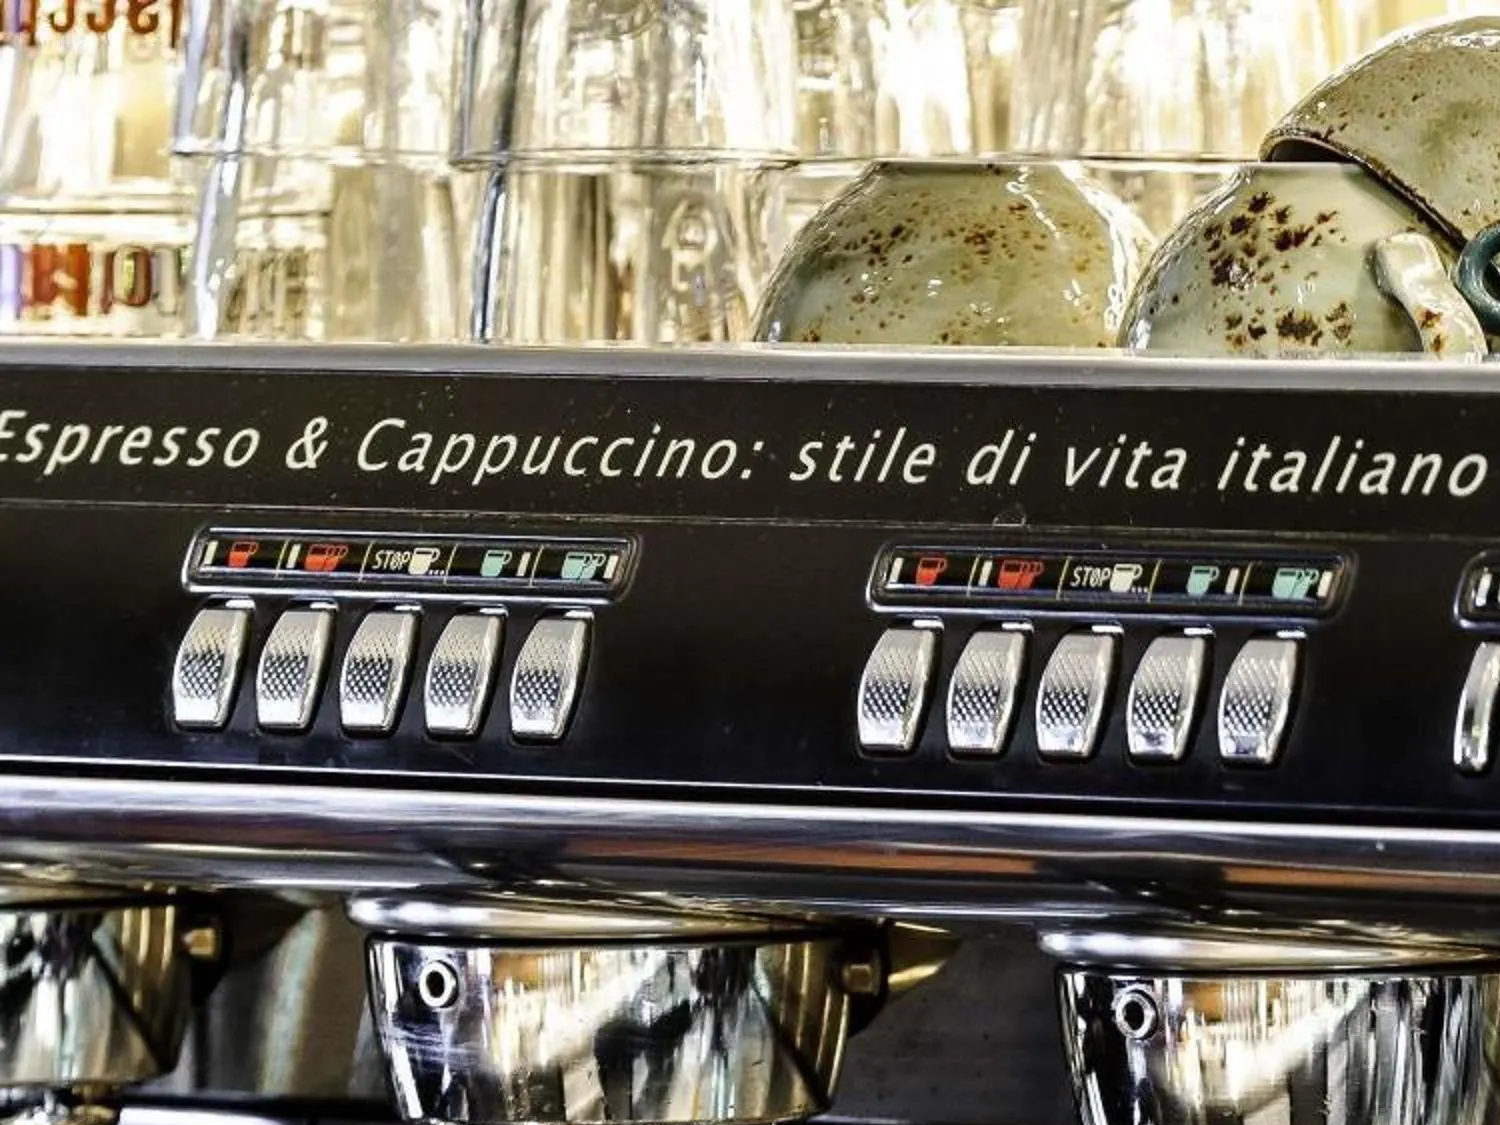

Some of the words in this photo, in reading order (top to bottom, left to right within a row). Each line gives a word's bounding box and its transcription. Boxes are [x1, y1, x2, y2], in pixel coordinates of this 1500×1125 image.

[0, 409, 260, 475] Espresso
[285, 416, 329, 469] &
[357, 417, 764, 486] Cappuccino:
[789, 427, 936, 484] stile
[966, 429, 1037, 485] di
[1065, 434, 1187, 489] vita
[1217, 435, 1488, 497] italiano
[371, 550, 412, 571] STOP
[1069, 566, 1111, 588] STOP
